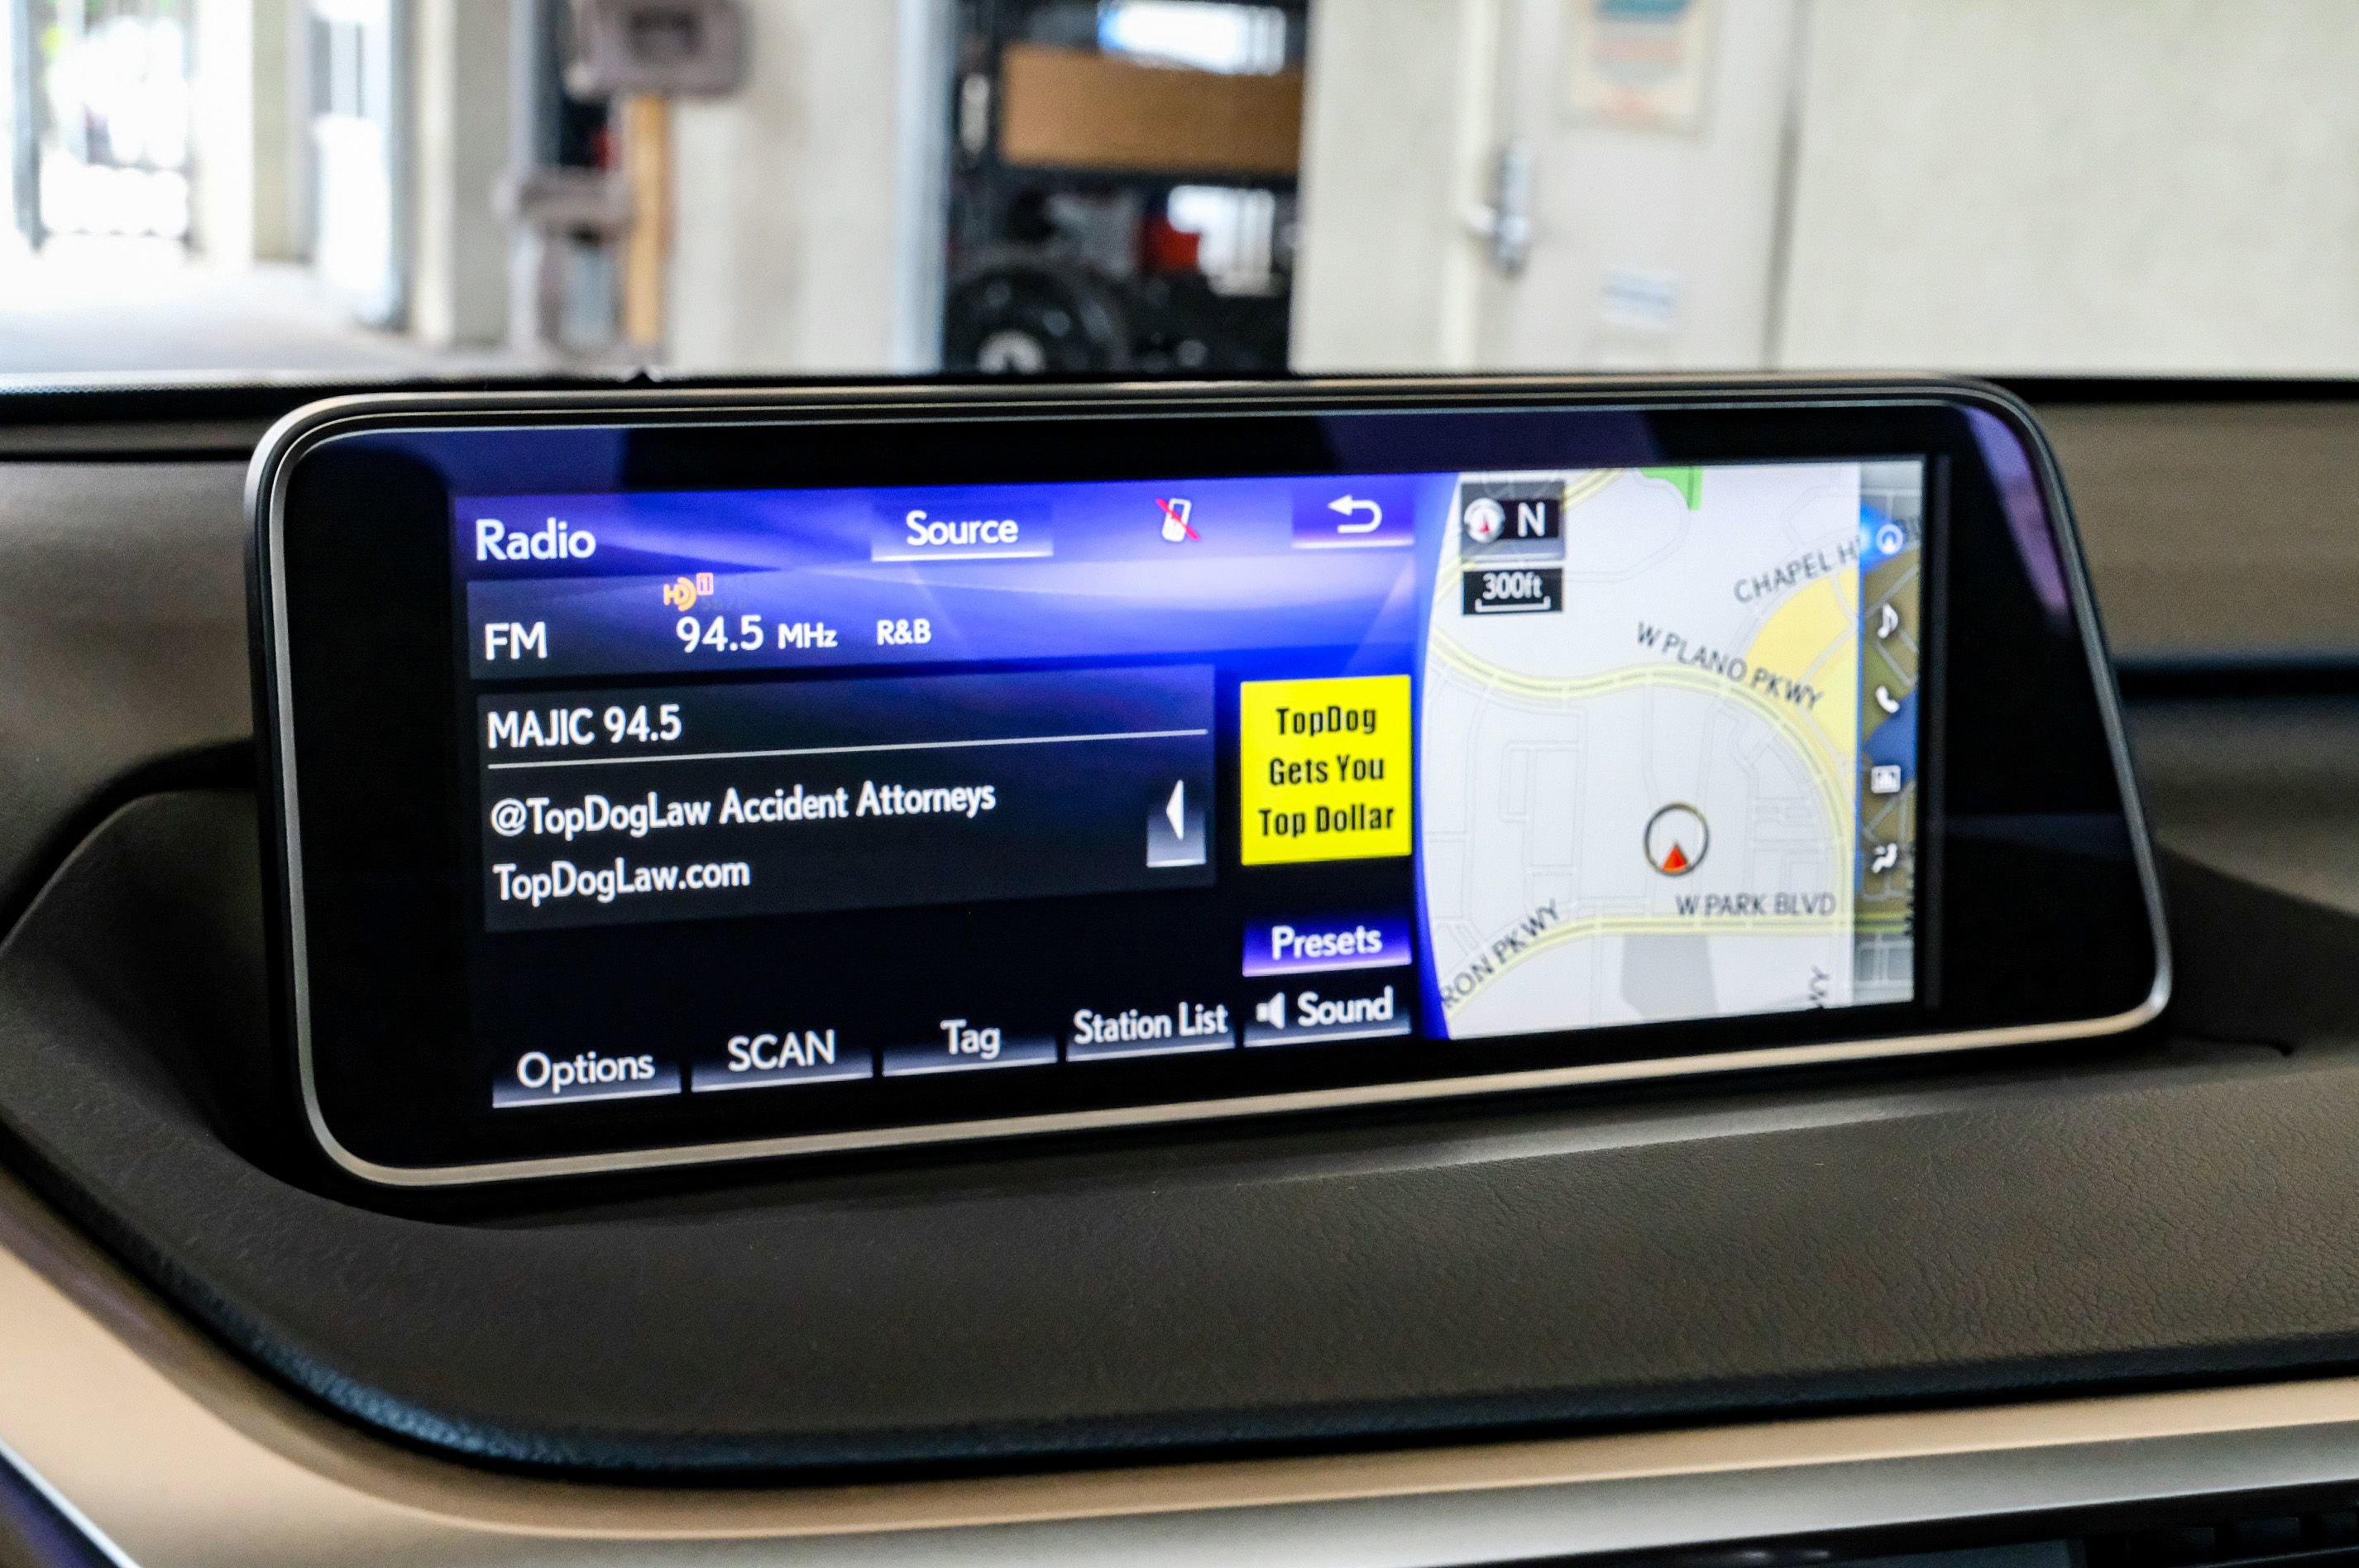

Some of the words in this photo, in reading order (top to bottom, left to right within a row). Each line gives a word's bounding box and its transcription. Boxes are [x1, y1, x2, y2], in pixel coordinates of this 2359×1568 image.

[476, 519, 596, 561] Radio
[907, 510, 1020, 547] Source
[1517, 503, 1546, 537] N
[1482, 574, 1543, 600] 300ft
[1734, 551, 1831, 604] CHAPEL
[485, 621, 548, 661] FM
[676, 614, 764, 653] 94.5
[778, 623, 838, 649] MHz
[877, 619, 932, 645] R&B
[1636, 622, 1662, 647] W
[1663, 633, 1748, 684] PLANO
[1753, 667, 1822, 711] PKWY
[488, 709, 596, 749] MAJIC
[603, 704, 682, 743] 94.5
[1276, 705, 1376, 736] TopDog
[1270, 758, 1328, 785] Gets
[1337, 754, 1385, 781] You
[490, 792, 711, 840] @TopDogLaw
[719, 784, 849, 825] Accident
[856, 780, 997, 818] Attorneys
[1259, 809, 1306, 838] Top
[1316, 804, 1394, 832] Dollar
[493, 858, 751, 907] TopDogLaw.com
[1676, 895, 1701, 916] W
[1705, 893, 1768, 915] PARK
[1774, 892, 1836, 915] BLVD
[1270, 925, 1383, 960] Presets
[1492, 898, 1560, 965] PKWY
[1074, 1009, 1172, 1045] Station
[1178, 1002, 1228, 1037] List
[1297, 986, 1395, 1026] Sound
[727, 1029, 835, 1071] SCAN
[940, 1019, 1002, 1059] Tag
[517, 1051, 656, 1094] Options
